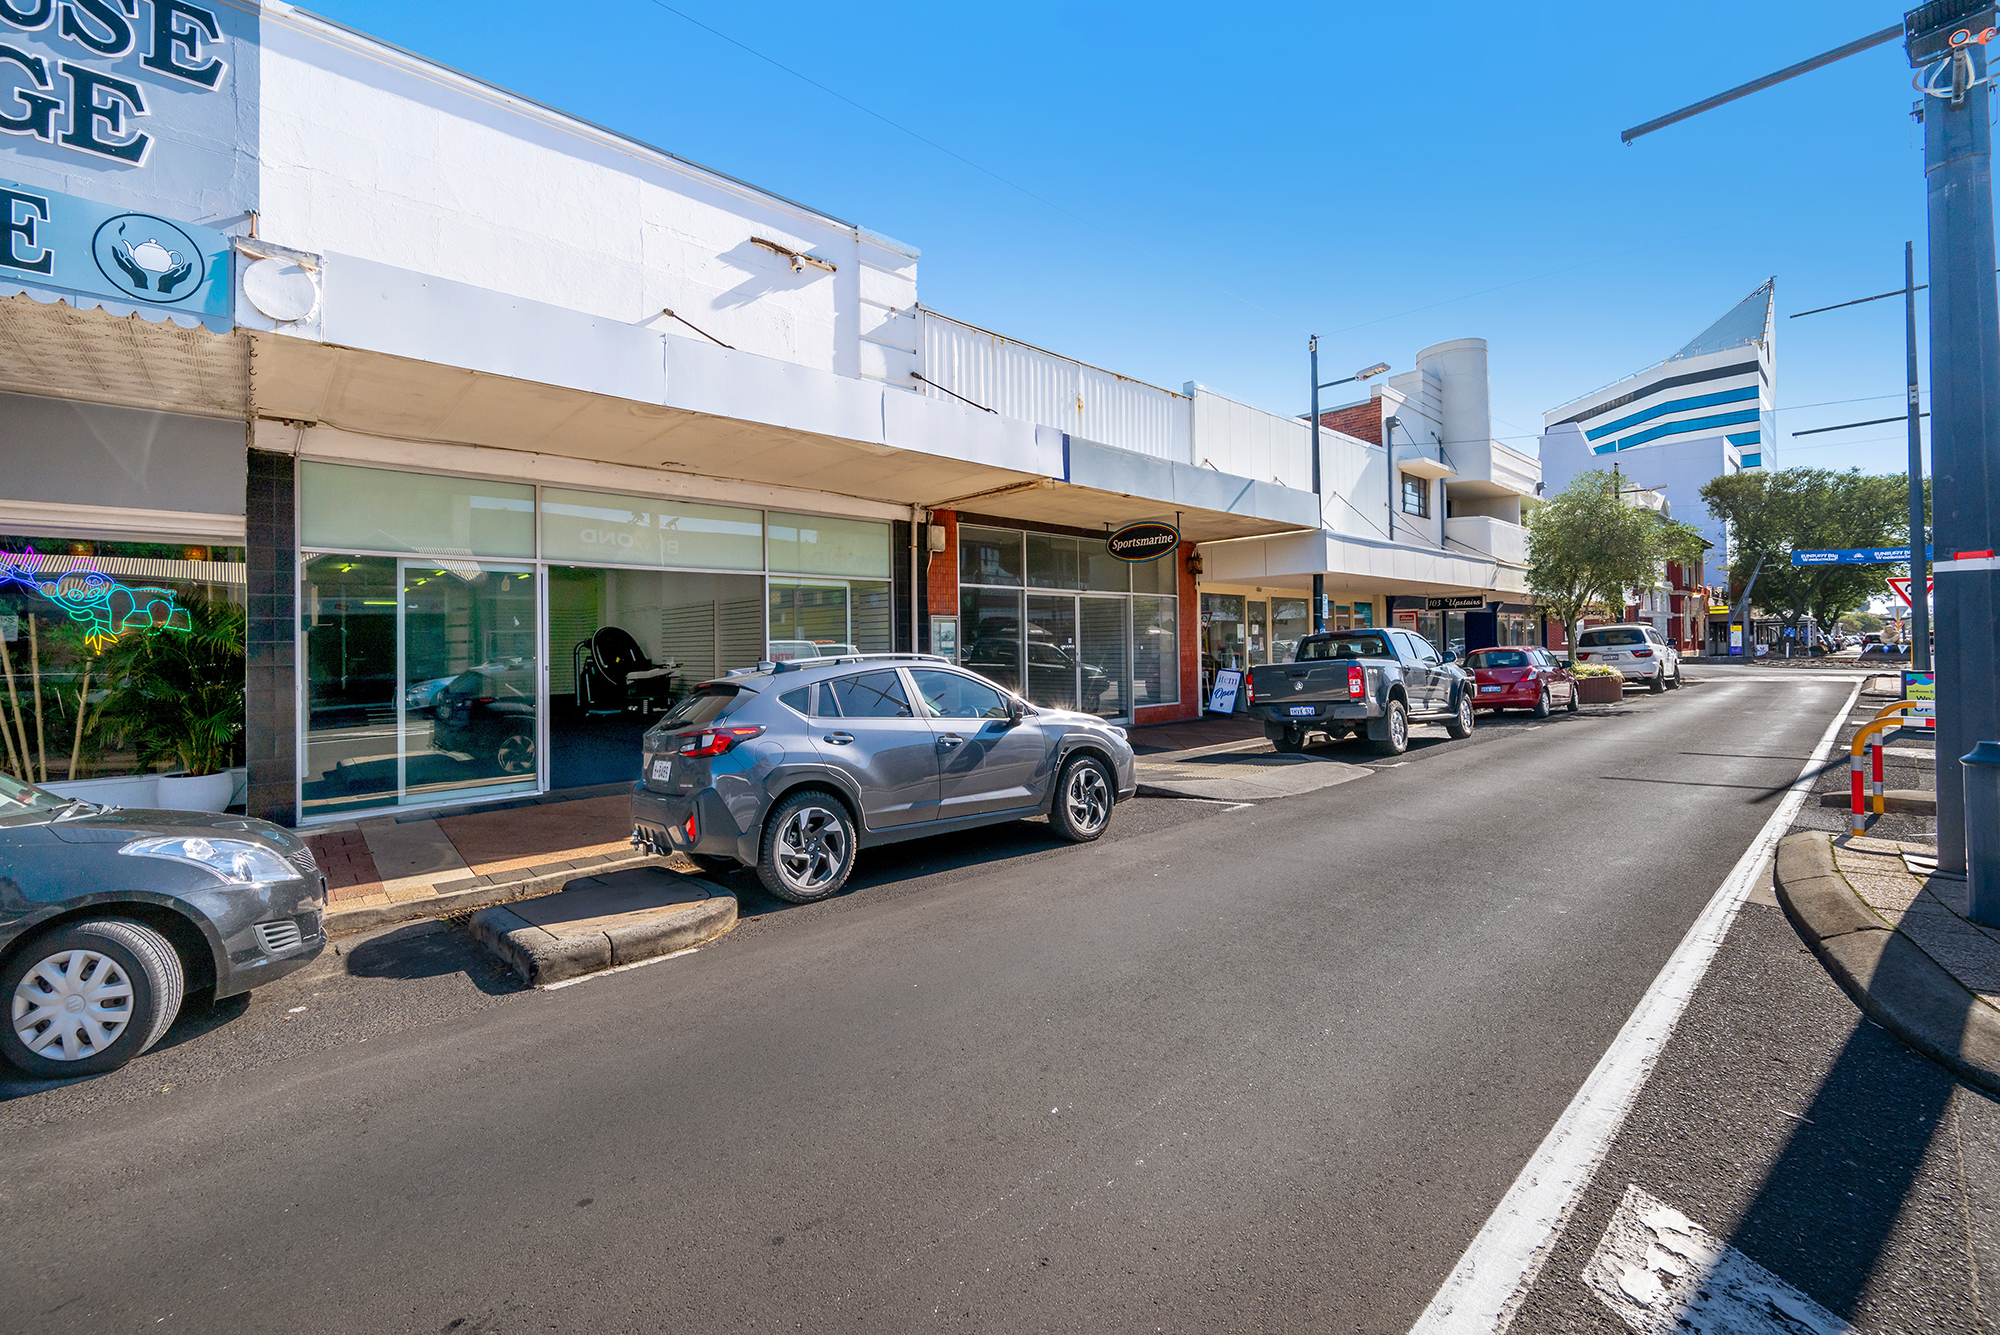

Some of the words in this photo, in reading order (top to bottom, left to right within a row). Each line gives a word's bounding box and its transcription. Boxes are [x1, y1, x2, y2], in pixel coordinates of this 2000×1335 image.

[1112, 533, 1174, 551] Sportsmarine
[1428, 599, 1441, 607] 103
[1445, 597, 1482, 609] Upstairs
[769, 653, 795, 663] ENTRY
[1217, 674, 1238, 685] item
[1214, 687, 1236, 700] Open
